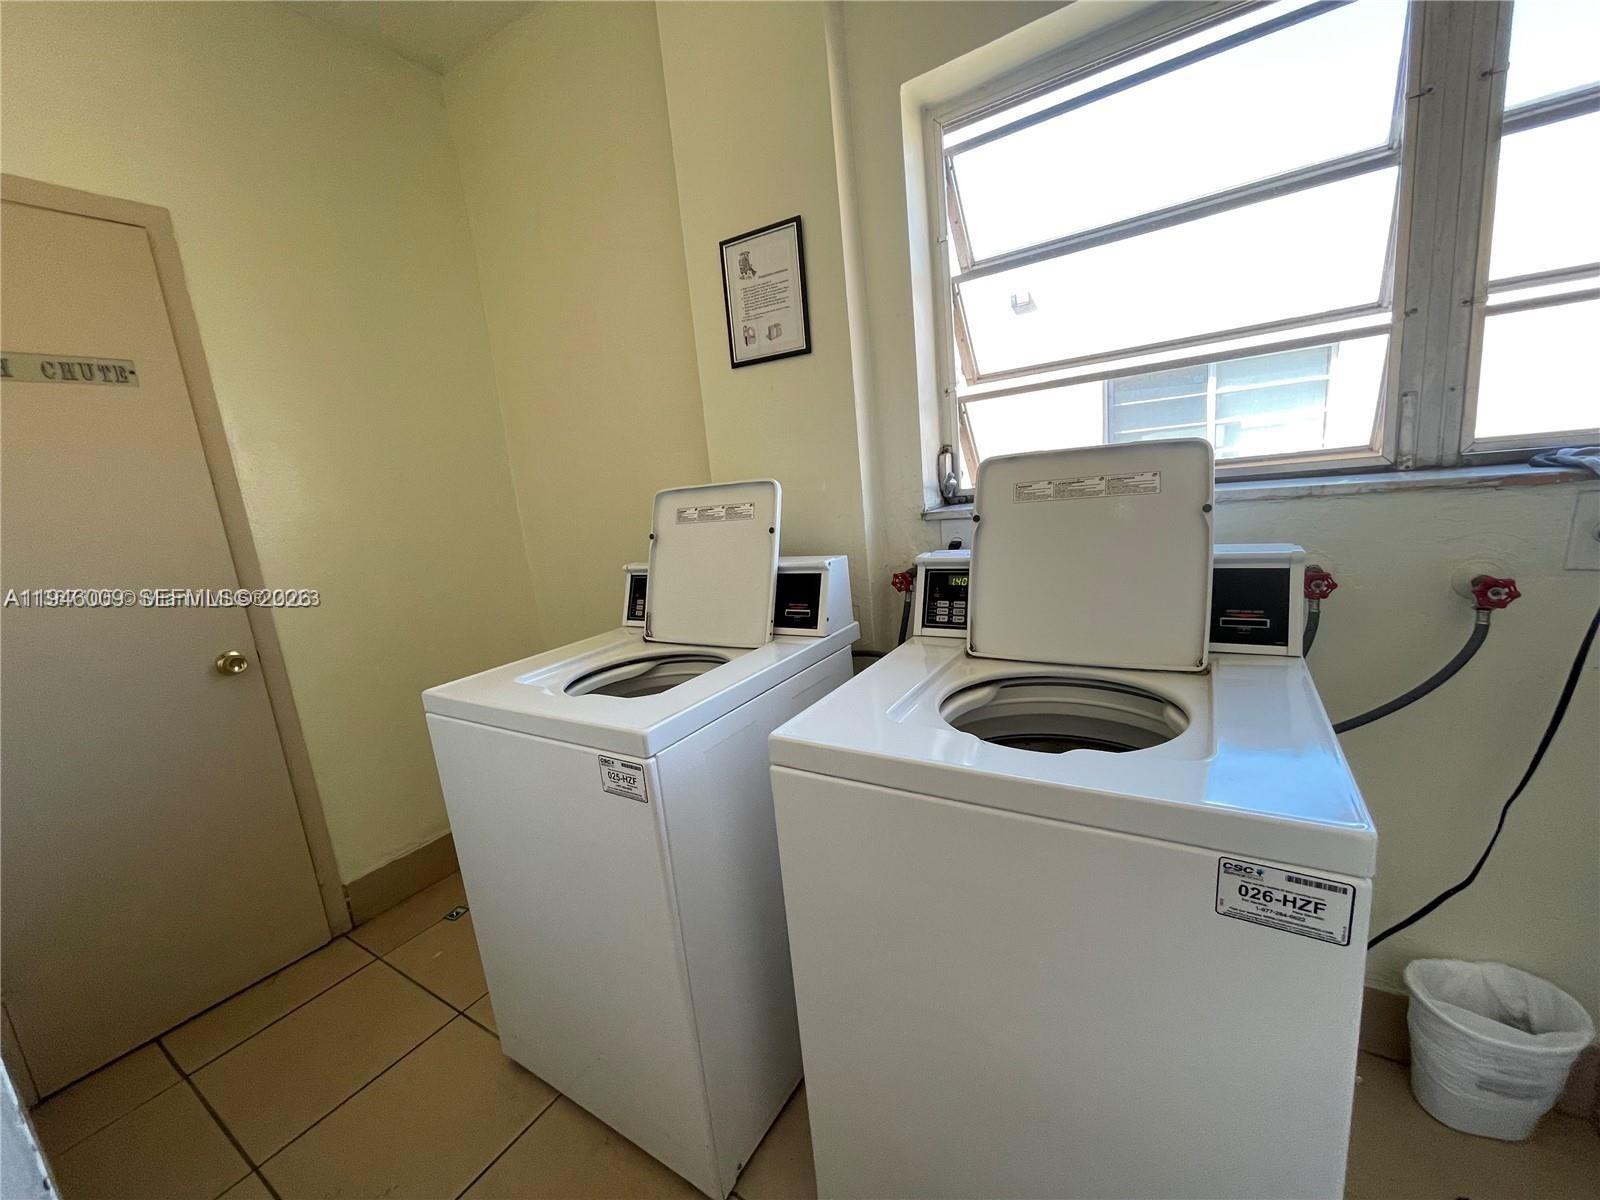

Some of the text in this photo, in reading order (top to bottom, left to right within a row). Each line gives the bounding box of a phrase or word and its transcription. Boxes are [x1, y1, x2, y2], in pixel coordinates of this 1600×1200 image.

[41, 361, 129, 383] CHUTE
[608, 771, 637, 785] 025-HZF
[1223, 862, 1254, 874] CSC
[1238, 884, 1327, 915] 026-HZF
